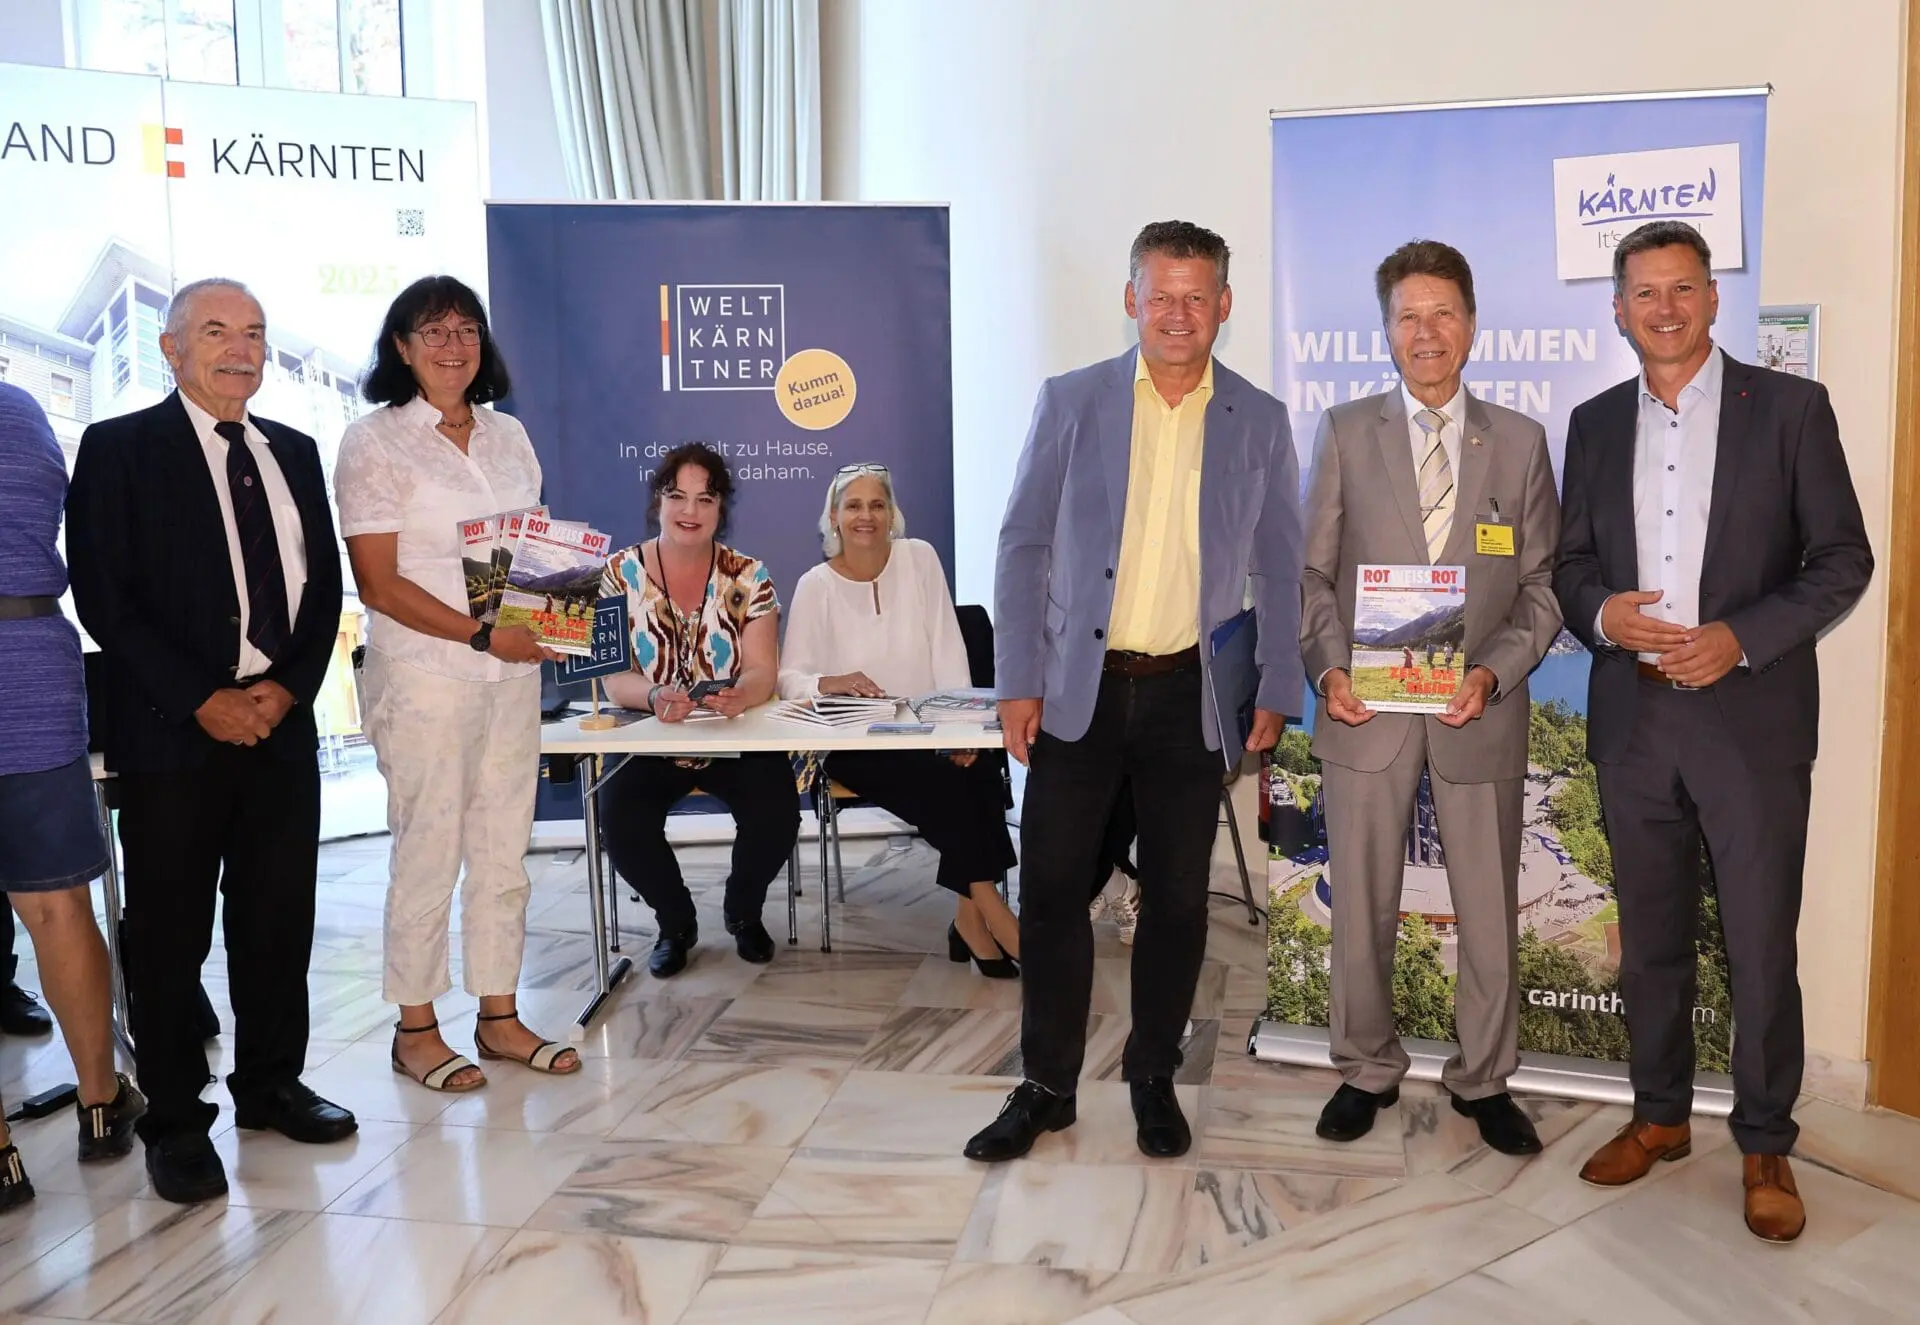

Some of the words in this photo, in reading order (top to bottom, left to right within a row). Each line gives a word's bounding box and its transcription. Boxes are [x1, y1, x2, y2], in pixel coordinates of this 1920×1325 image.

[212, 132, 426, 183] KÄRNTEN
[1578, 167, 1717, 217] KÄRNTEN
[1597, 230, 1622, 249] It's
[688, 295, 773, 317] WELT
[689, 324, 774, 348] KÄRN
[1289, 328, 1596, 363] WILLMMEN
[690, 358, 775, 380] TNER
[787, 371, 840, 396] Kumm
[1294, 379, 1335, 413] IN
[1349, 371, 1551, 414] KÄTEN
[792, 385, 846, 412] dazua!
[619, 442, 638, 458] In
[682, 440, 729, 457] elt
[735, 443, 759, 456] zu
[766, 440, 833, 458] Hause,
[738, 463, 816, 481] daham.
[1527, 987, 1716, 1025] carinthm
